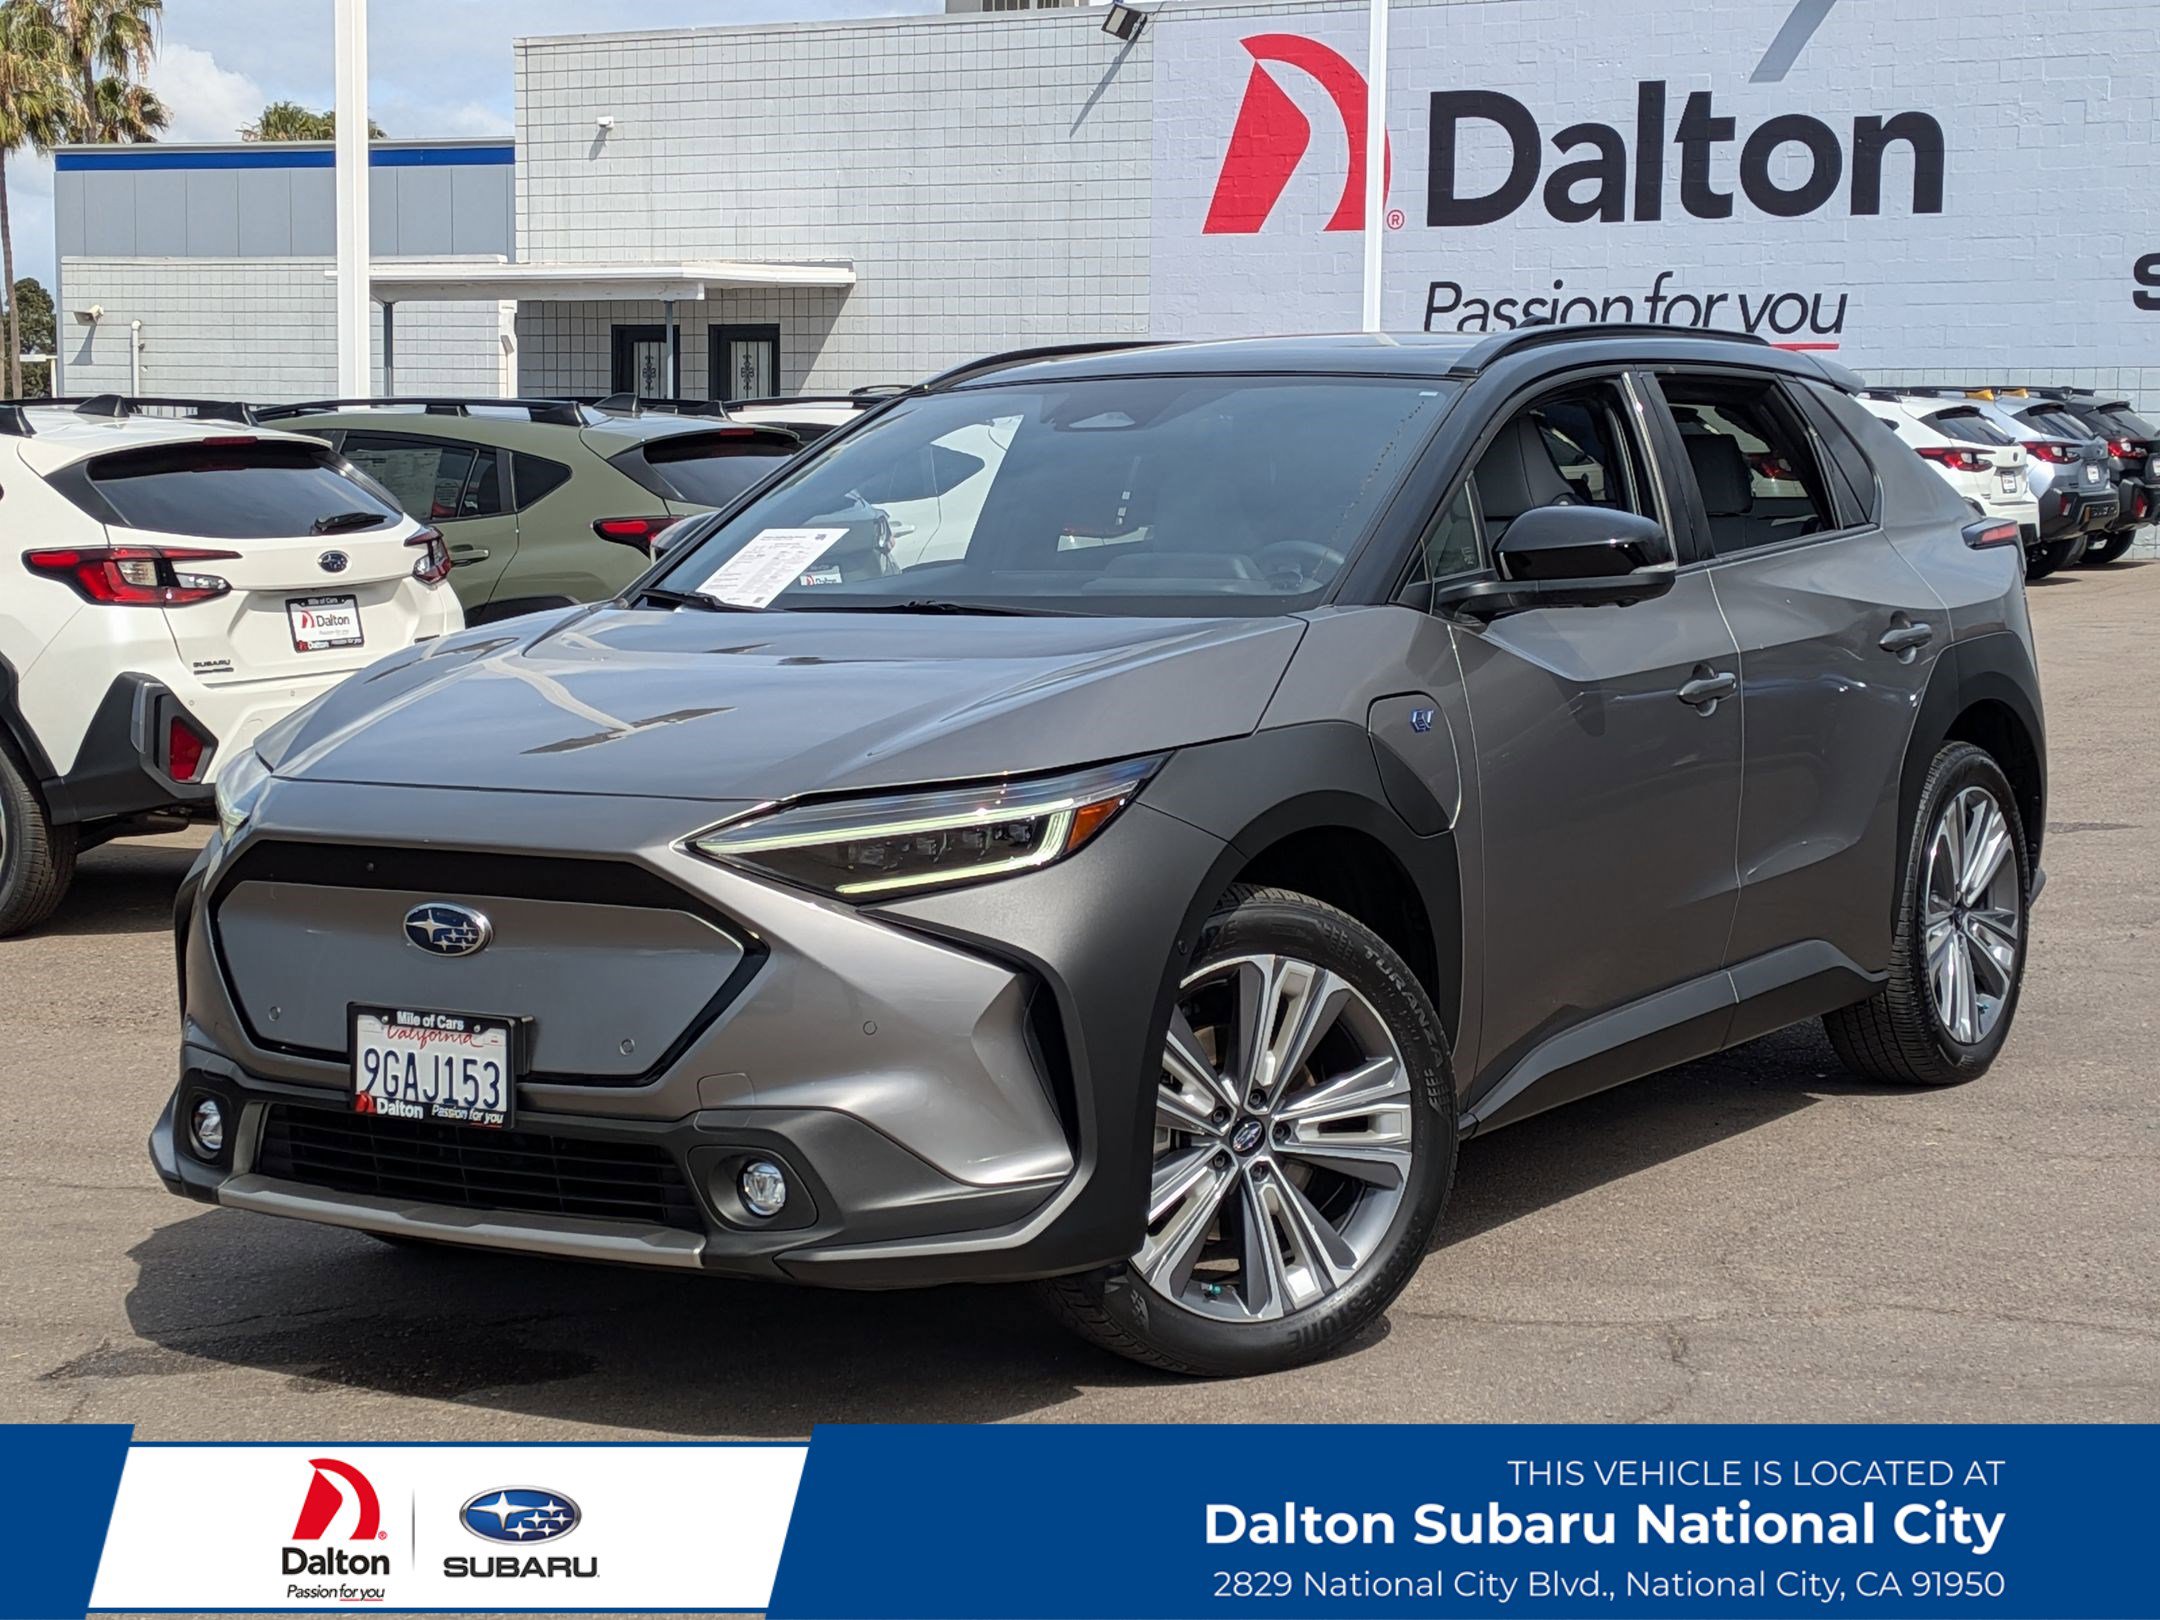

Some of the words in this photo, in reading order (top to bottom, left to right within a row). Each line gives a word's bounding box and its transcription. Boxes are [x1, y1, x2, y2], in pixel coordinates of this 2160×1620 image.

[1427, 81, 1944, 226] Dalton
[1424, 278, 1634, 332] Passion
[1644, 271, 1728, 330] for
[1739, 292, 1848, 335] you
[316, 614, 350, 627] Dalton
[396, 1011, 421, 1026] Mile
[422, 1014, 436, 1028] of
[437, 1015, 464, 1031] Cars
[1363, 944, 1443, 1067] TURANZA
[363, 1047, 501, 1109] 9GAJ153
[376, 1097, 424, 1119] Dalton
[431, 1104, 468, 1120] Passion
[468, 1107, 484, 1121] for
[484, 1112, 504, 1125] you
